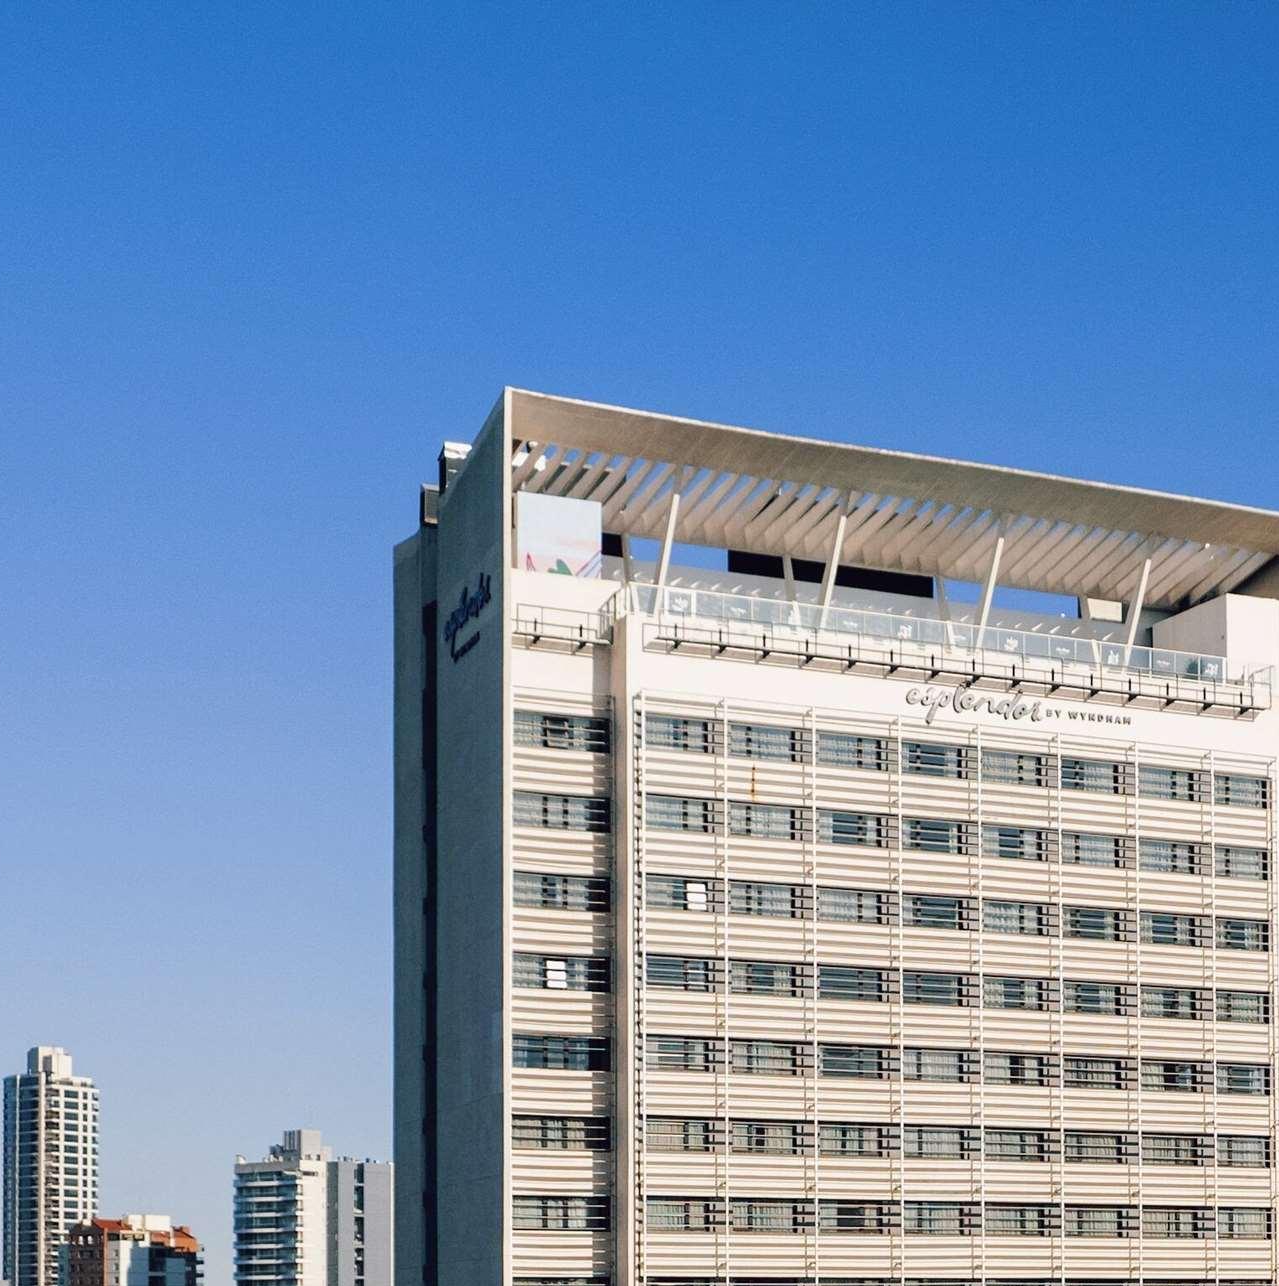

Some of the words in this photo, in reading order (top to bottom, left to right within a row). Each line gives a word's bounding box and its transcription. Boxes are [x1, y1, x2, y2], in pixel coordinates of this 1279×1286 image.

[906, 681, 1043, 725] esplendor
[1045, 709, 1062, 719] BY
[1068, 710, 1132, 726] WYNDHAM
